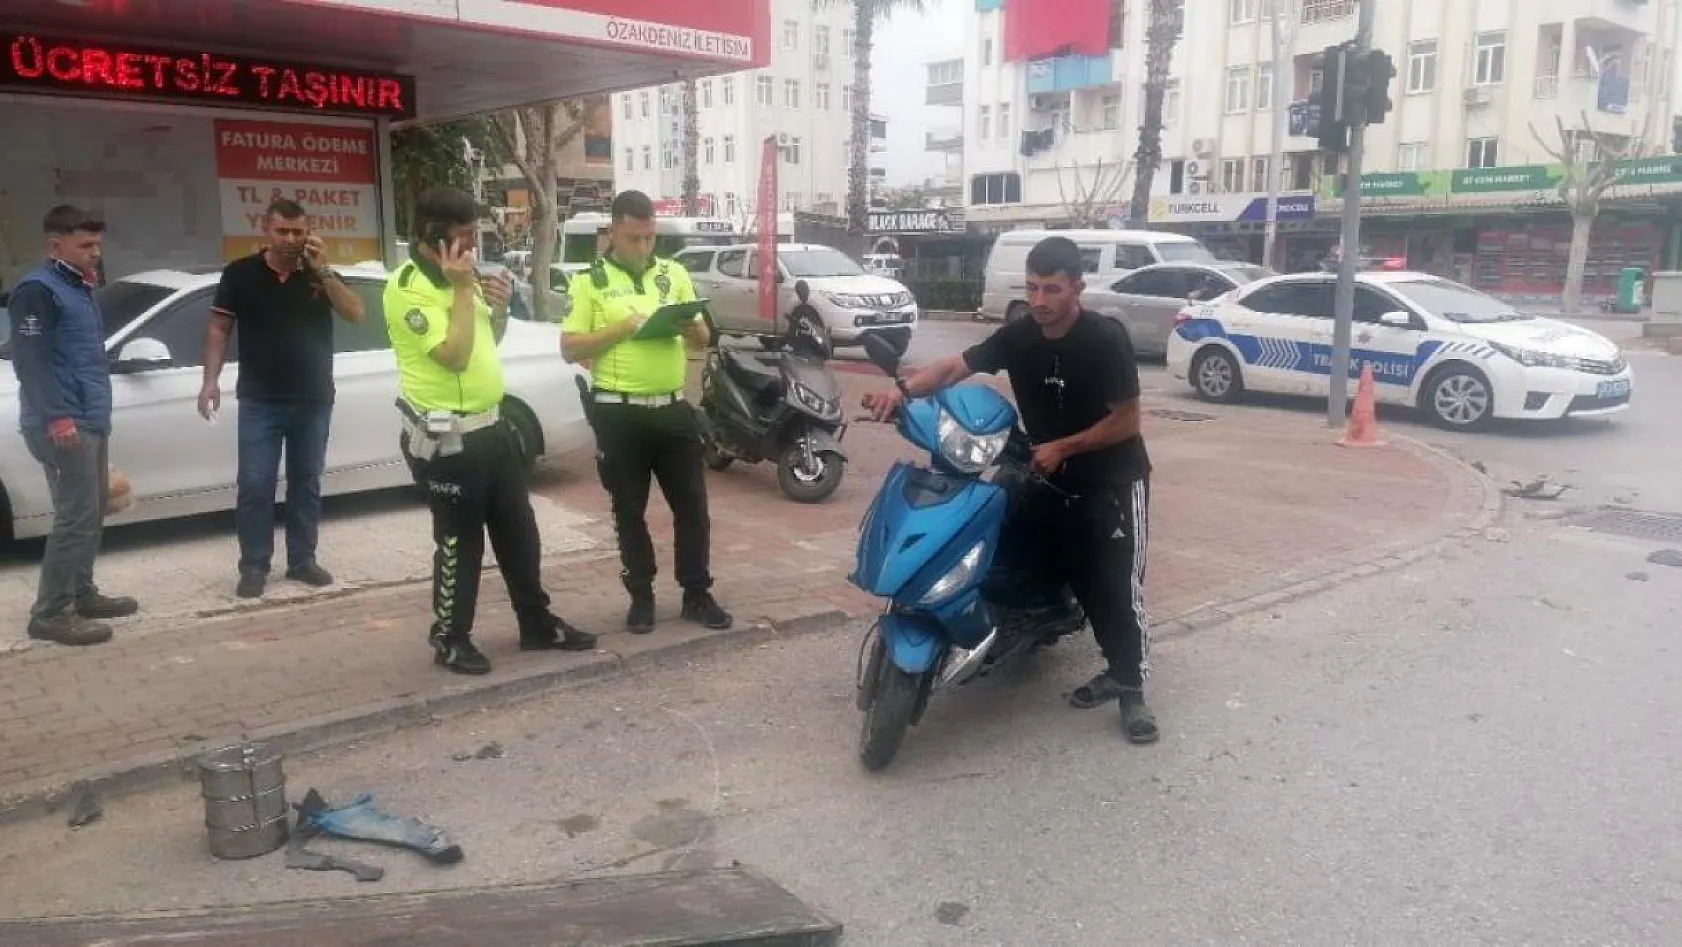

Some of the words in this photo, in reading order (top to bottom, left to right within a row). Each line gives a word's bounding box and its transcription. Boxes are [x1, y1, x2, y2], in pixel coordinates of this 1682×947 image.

[12, 36, 240, 95] ÜCRETSİZ
[251, 66, 404, 111] TAŞINIR
[221, 130, 297, 150] FATURA
[301, 132, 368, 154] ÖDEME
[256, 154, 339, 174] MERKEZİ
[237, 185, 263, 204] TL
[295, 188, 361, 207] PAKET
[1167, 203, 1220, 214] TURKCELL
